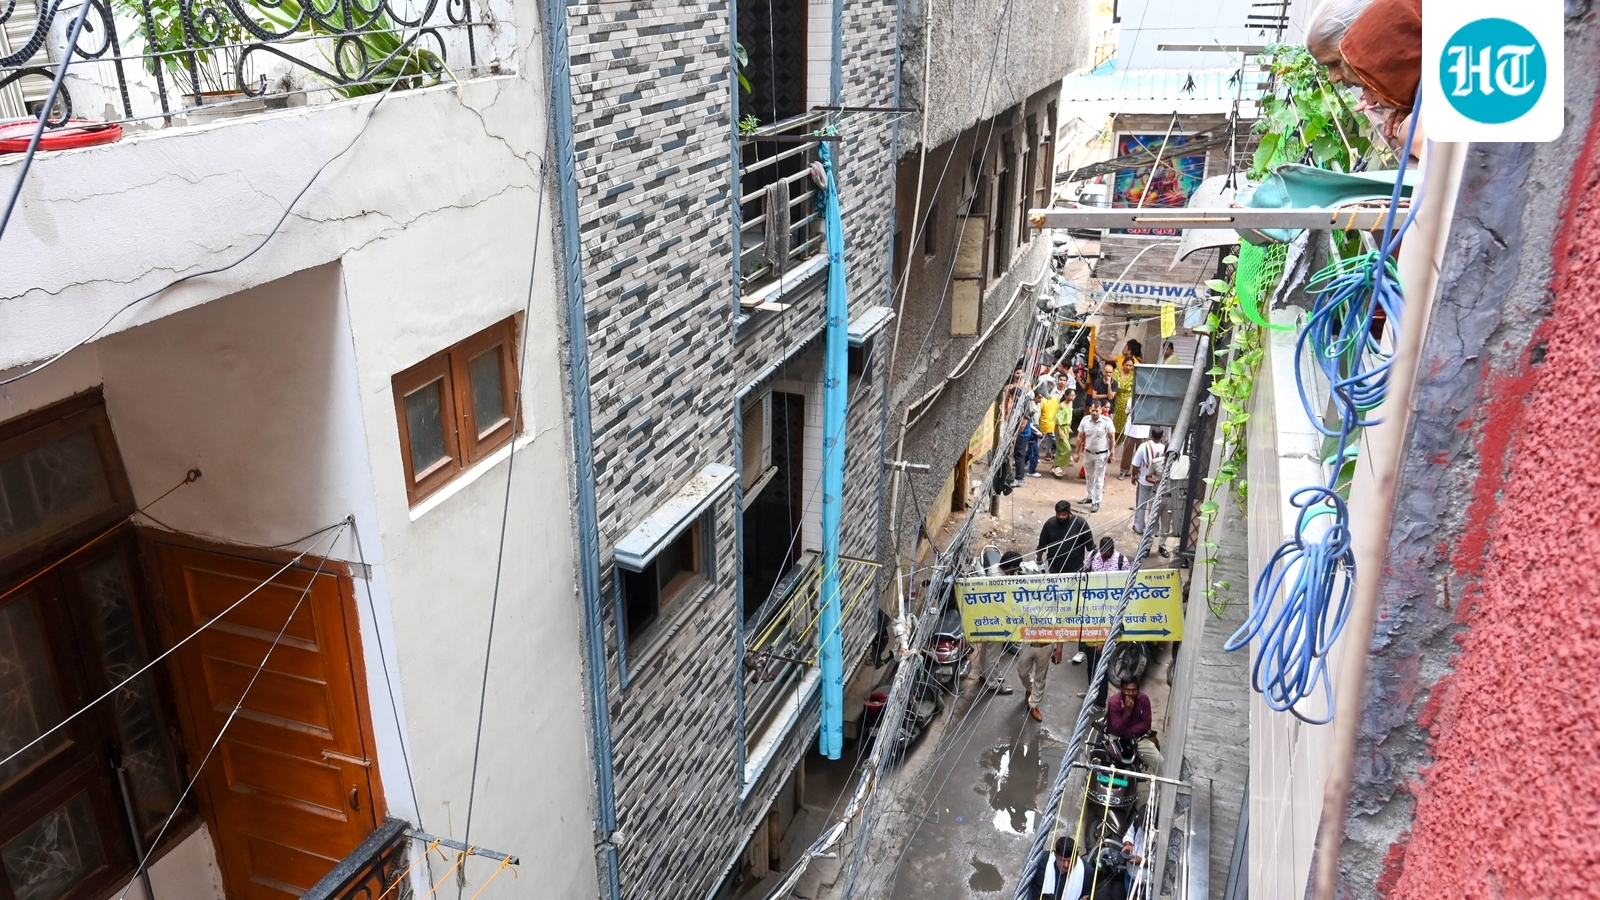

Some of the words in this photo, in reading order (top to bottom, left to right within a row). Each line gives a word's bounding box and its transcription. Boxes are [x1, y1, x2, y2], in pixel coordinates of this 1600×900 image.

[1102, 281, 1198, 298] WADHWA
[963, 587, 1007, 606] संजय
[1011, 584, 1075, 604] प्रोपर्टीज
[1124, 613, 1147, 624] संपर्क
